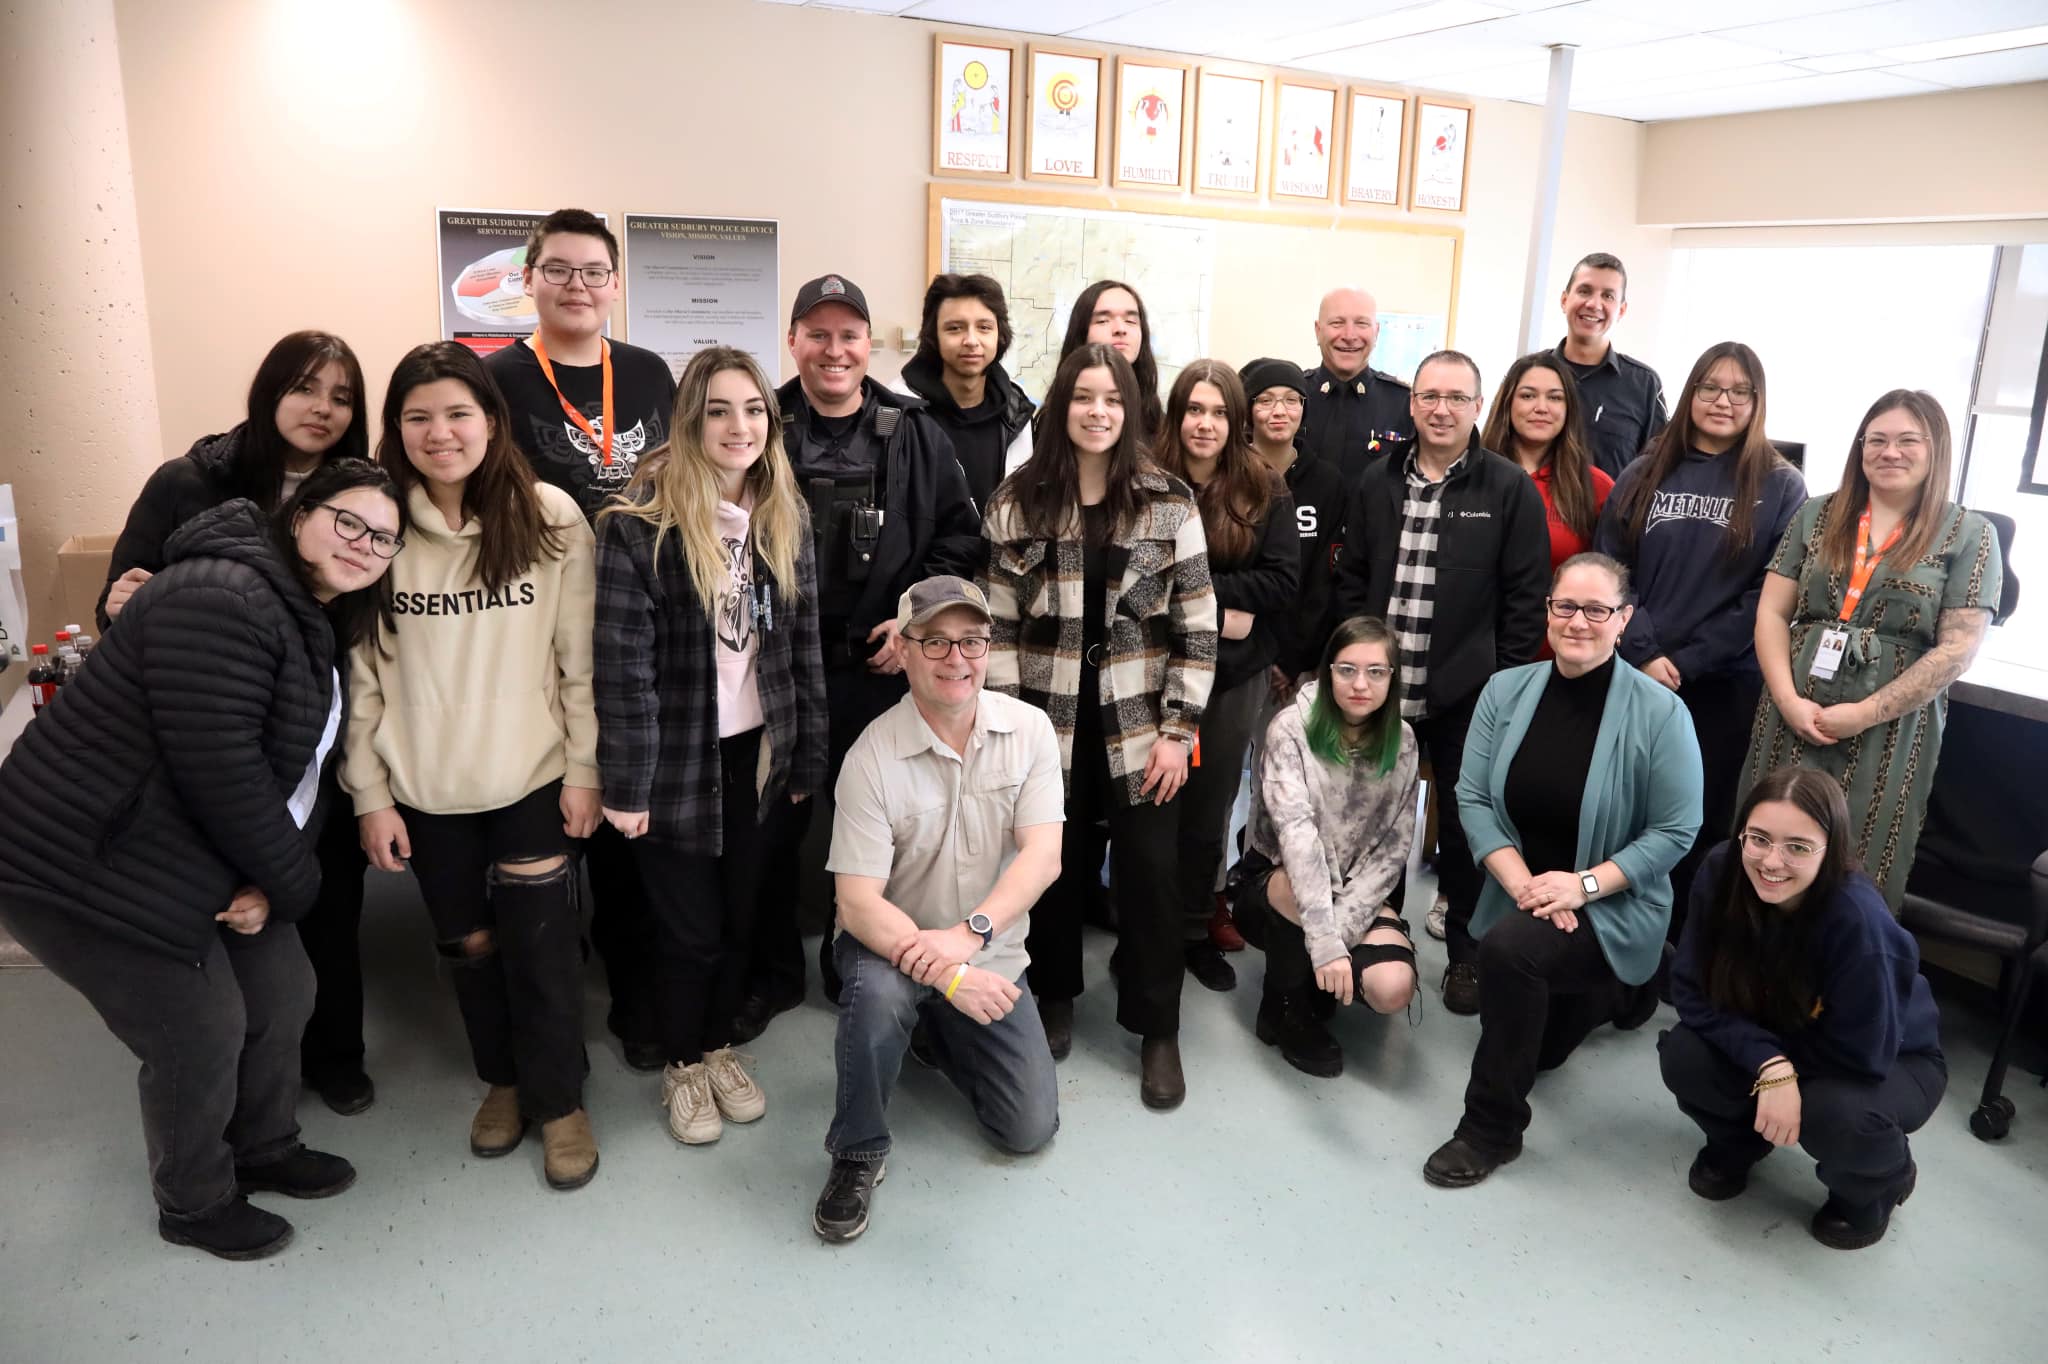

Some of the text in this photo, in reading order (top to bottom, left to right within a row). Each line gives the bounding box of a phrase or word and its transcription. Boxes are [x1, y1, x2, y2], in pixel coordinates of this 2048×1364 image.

[947, 151, 1001, 169] RESPECT
[1044, 157, 1083, 174] LOVE
[1122, 165, 1176, 183] HUMILITY
[1207, 172, 1250, 189] TRUTH
[1281, 180, 1324, 195] WISDOM
[1350, 186, 1394, 202] BRAVERY
[1417, 193, 1458, 209] HONESTY
[447, 216, 488, 226] GREATER
[489, 218, 530, 228] SUDBURY
[630, 221, 775, 235] GREATER SUDBURY POLICE SERVICE
[477, 228, 507, 236] SERVICE
[719, 234, 747, 242] VALUES
